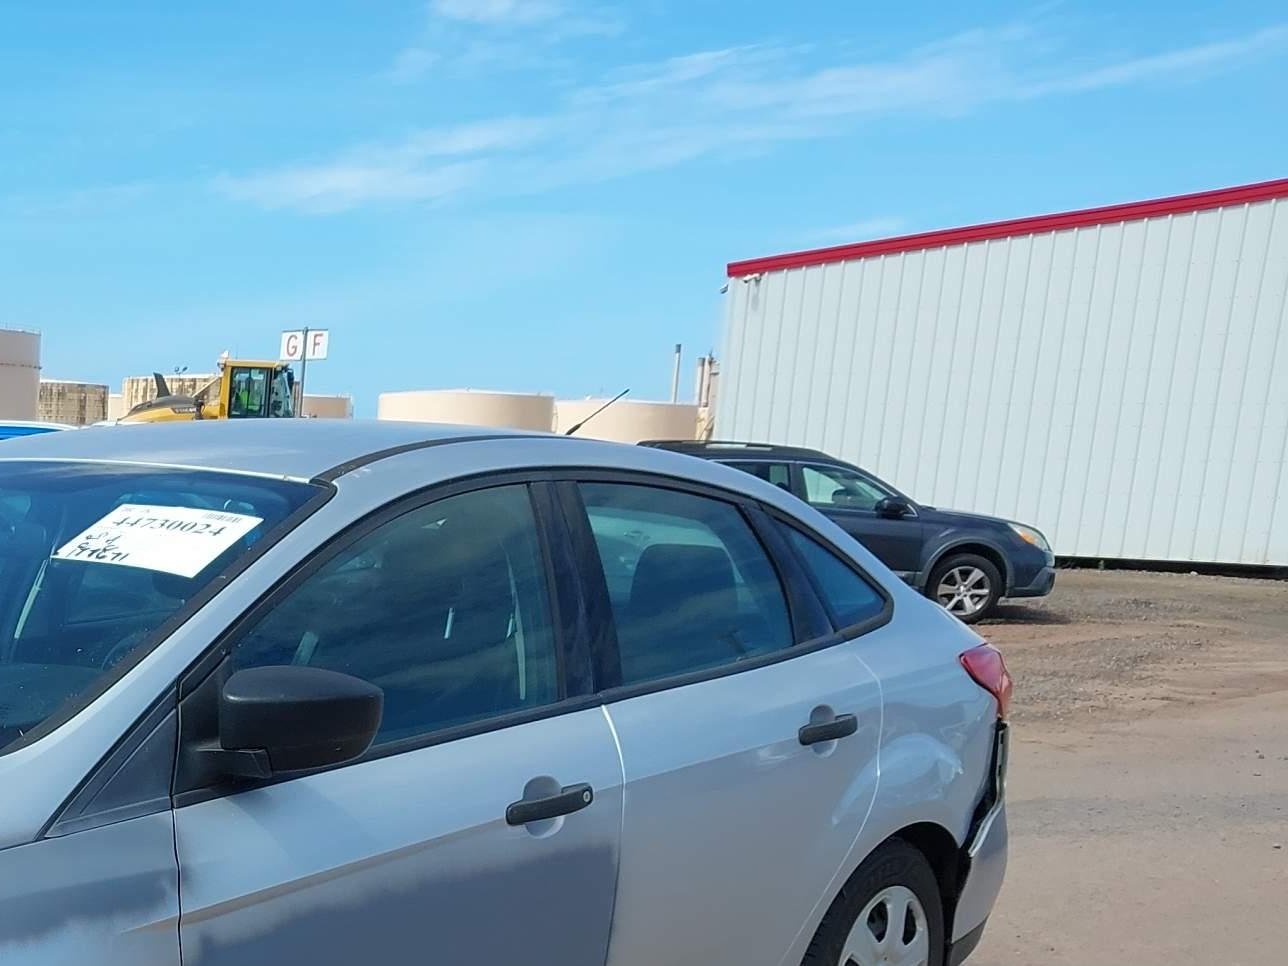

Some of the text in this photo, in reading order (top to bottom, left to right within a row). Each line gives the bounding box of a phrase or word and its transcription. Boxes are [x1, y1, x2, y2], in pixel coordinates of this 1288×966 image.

[286, 334, 298, 357] G
[312, 333, 324, 356] F
[113, 516, 227, 537] 44730024
